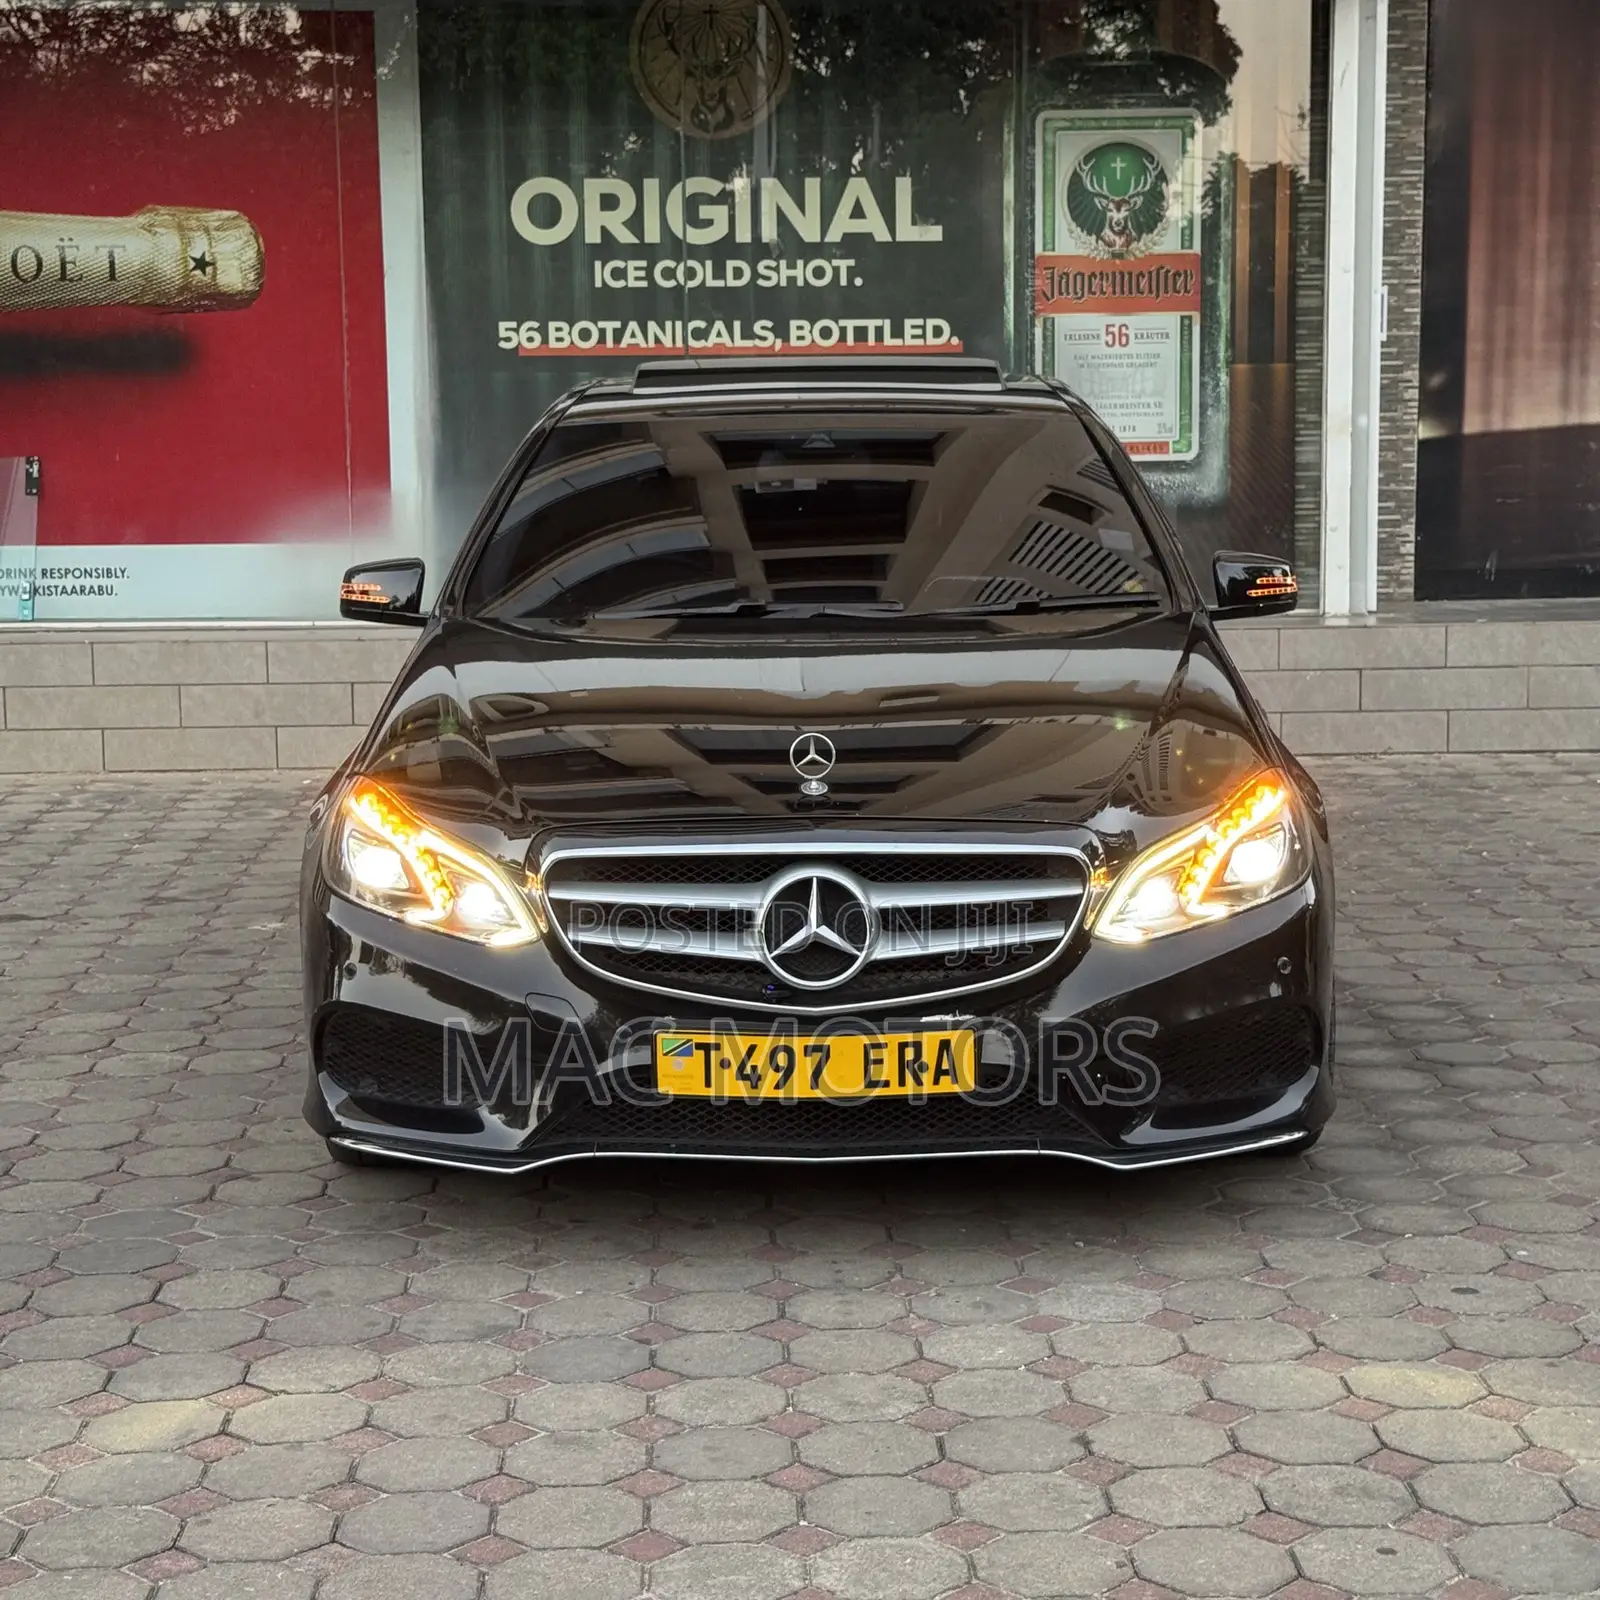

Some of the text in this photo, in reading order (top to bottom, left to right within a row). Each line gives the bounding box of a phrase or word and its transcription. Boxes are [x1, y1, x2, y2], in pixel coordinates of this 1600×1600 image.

[510, 176, 943, 246] ORIGINAL
[594, 259, 864, 288] ICE COLD SHOT.
[498, 318, 960, 352] 56 BOTANICALS, BOTTLED.
[1104, 324, 1130, 348] 56
[41, 567, 130, 579] RESPONSIBLY.
[863, 1038, 959, 1089] ERA
